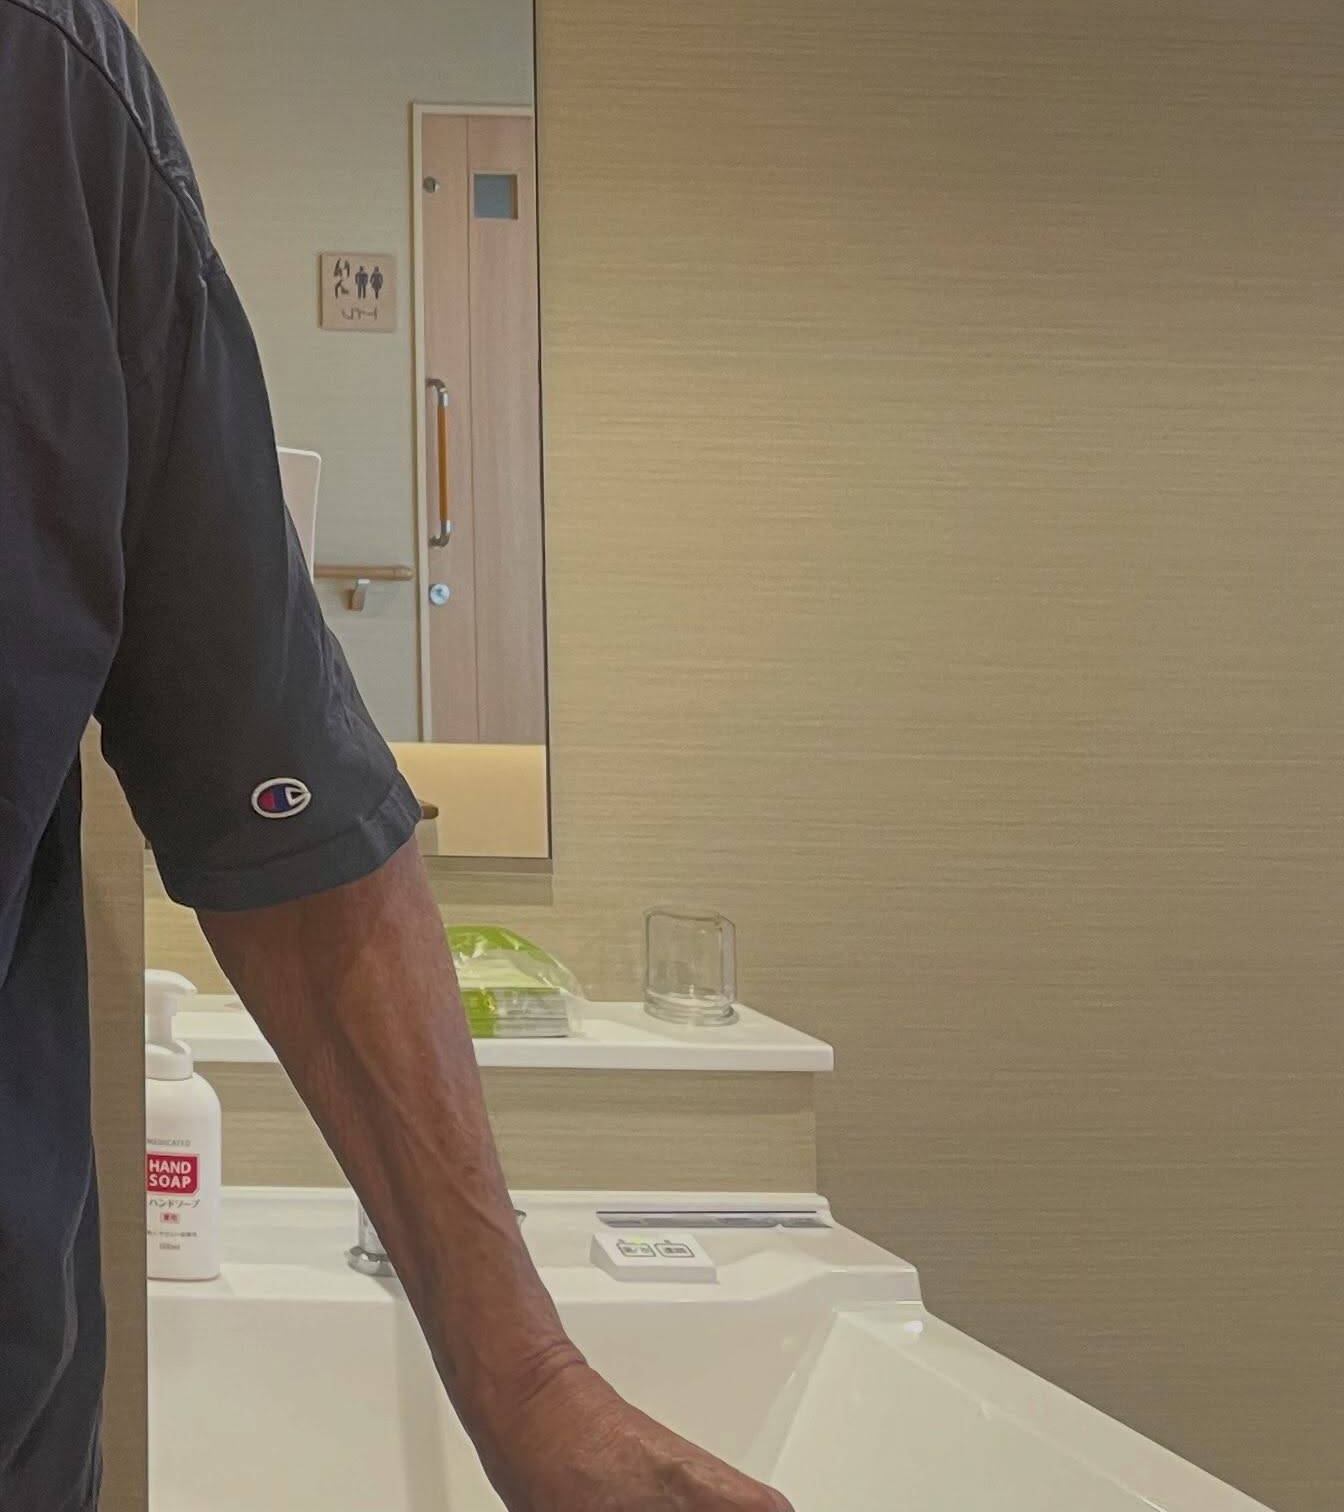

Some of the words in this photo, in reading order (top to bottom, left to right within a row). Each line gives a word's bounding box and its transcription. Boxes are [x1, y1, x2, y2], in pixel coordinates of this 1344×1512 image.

[148, 1159, 192, 1175] HAND
[148, 1174, 192, 1189] SOAP
[149, 1198, 201, 1209] ハンドソープ
